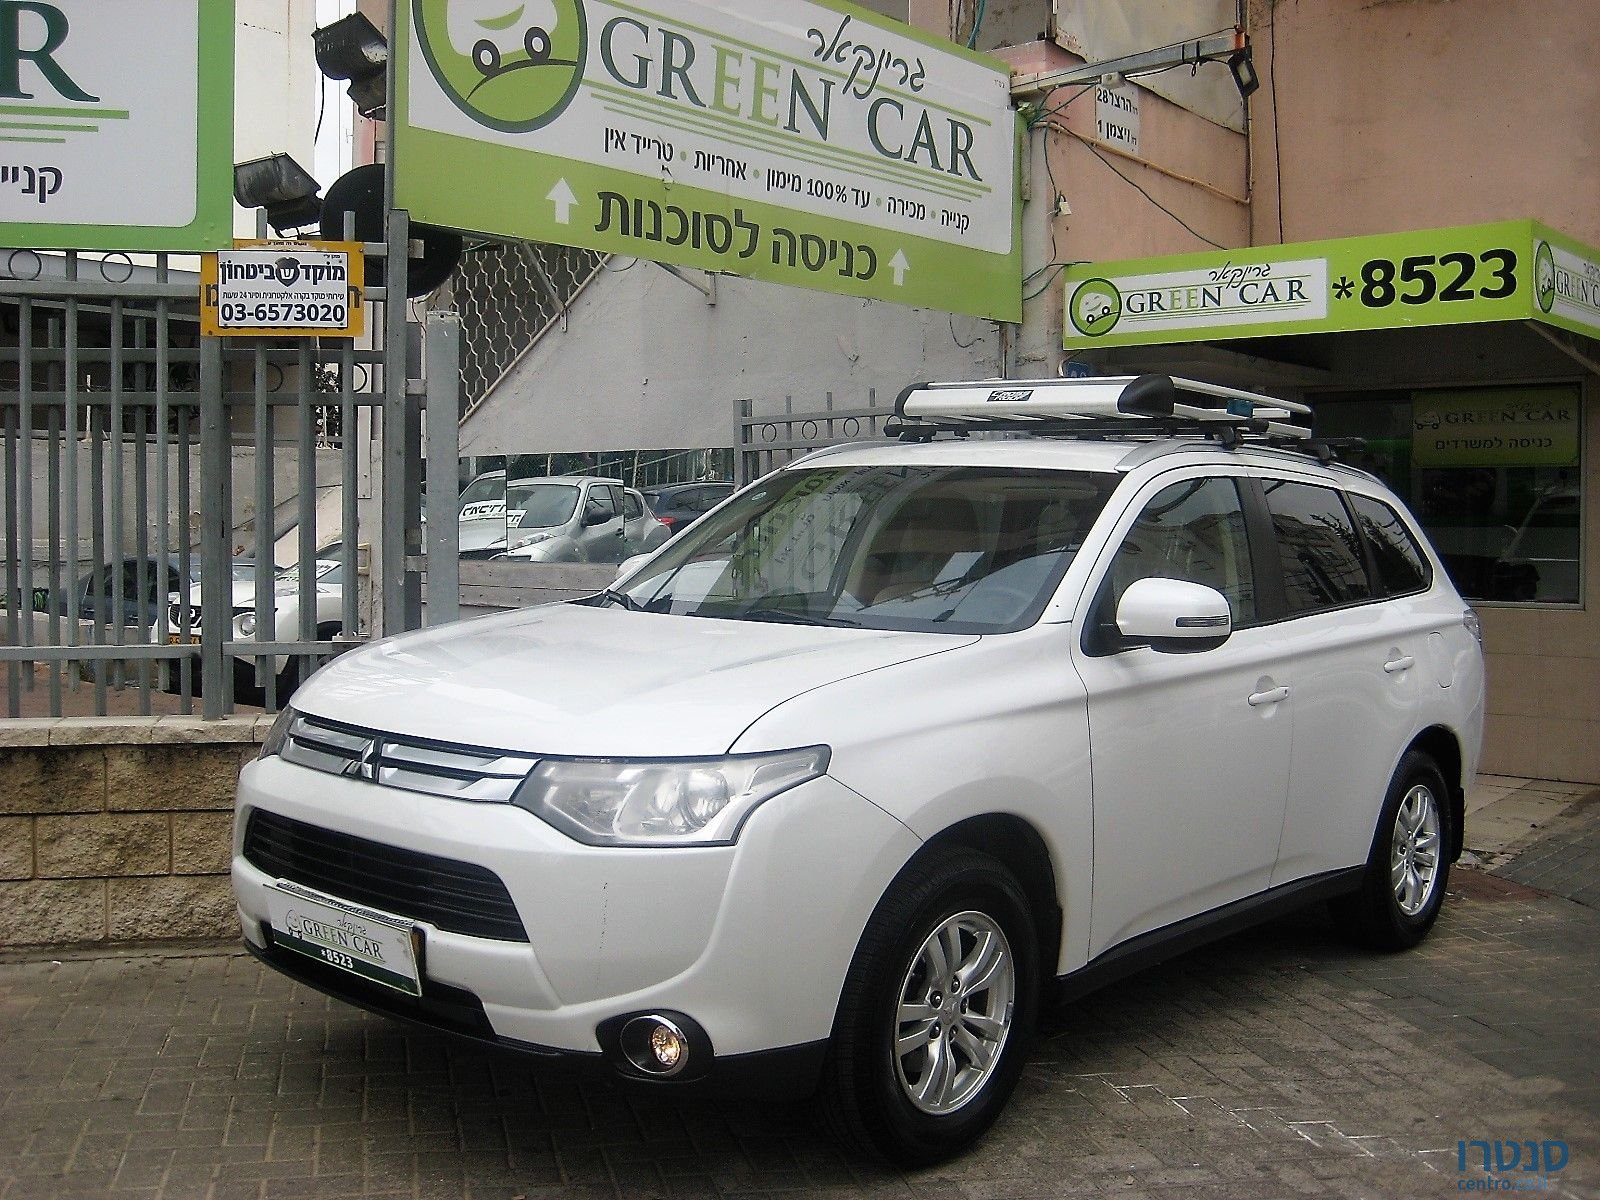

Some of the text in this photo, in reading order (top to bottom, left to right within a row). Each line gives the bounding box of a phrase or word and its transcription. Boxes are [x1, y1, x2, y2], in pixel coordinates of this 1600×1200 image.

[600, 16, 983, 182] GREEN CAR
[1097, 119, 1102, 133] 1
[1106, 122, 1130, 142] ויצמן
[604, 127, 970, 234] קנייה מכירה עד 100% מימון אחריות טרייד אין
[594, 190, 877, 281] כניסה לסוכנות
[220, 260, 276, 285] ביטחון
[300, 262, 346, 285] מוקד
[239, 291, 247, 299] 24
[1125, 279, 1309, 314] GREEN CAR
[221, 303, 345, 322] 03-6573020
[1526, 409, 1571, 422] CAR
[1436, 436, 1552, 450] כניסה למשרדים
[303, 919, 384, 960] GREEN CAR
